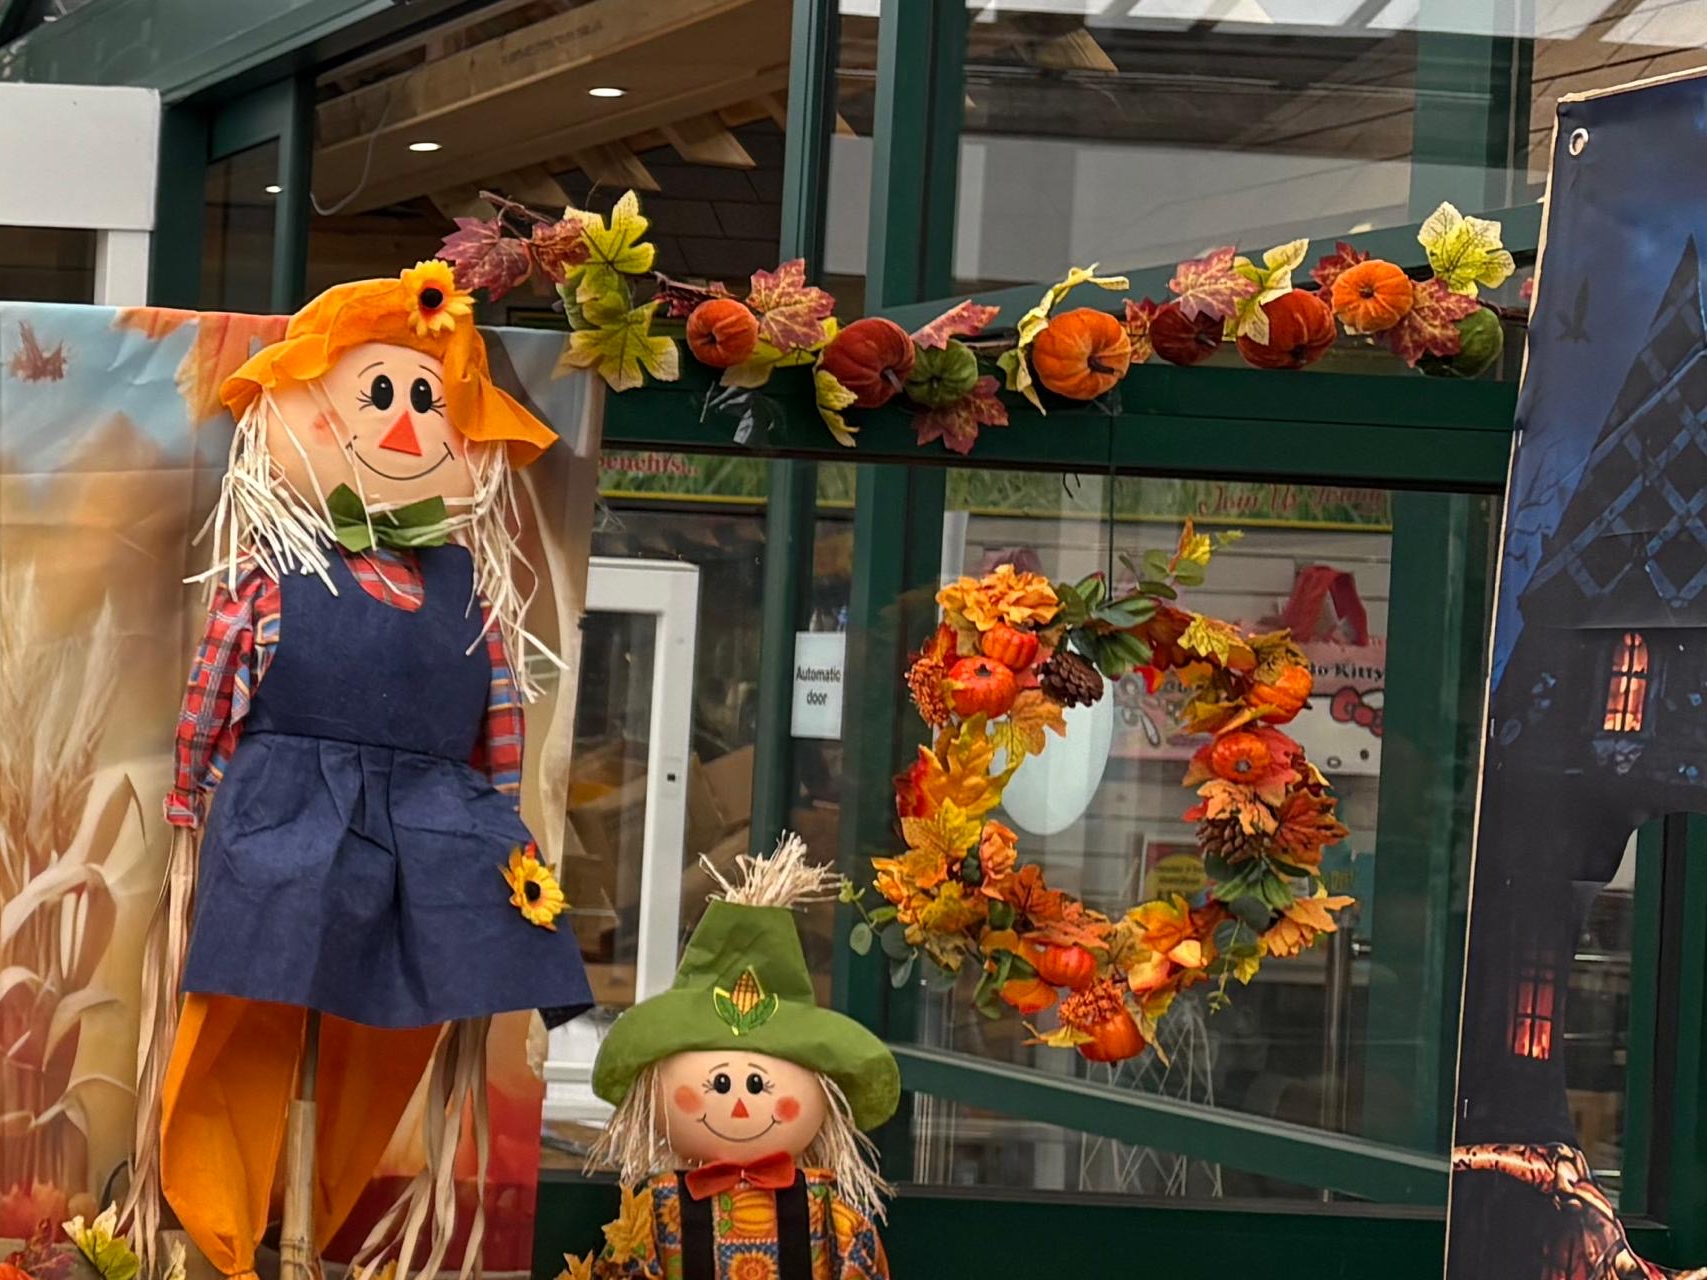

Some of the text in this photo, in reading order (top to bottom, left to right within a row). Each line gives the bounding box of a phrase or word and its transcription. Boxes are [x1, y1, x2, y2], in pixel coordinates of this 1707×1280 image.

[796, 666, 842, 682] Automatic
[1335, 663, 1383, 683] Kitty
[806, 689, 828, 706] door
